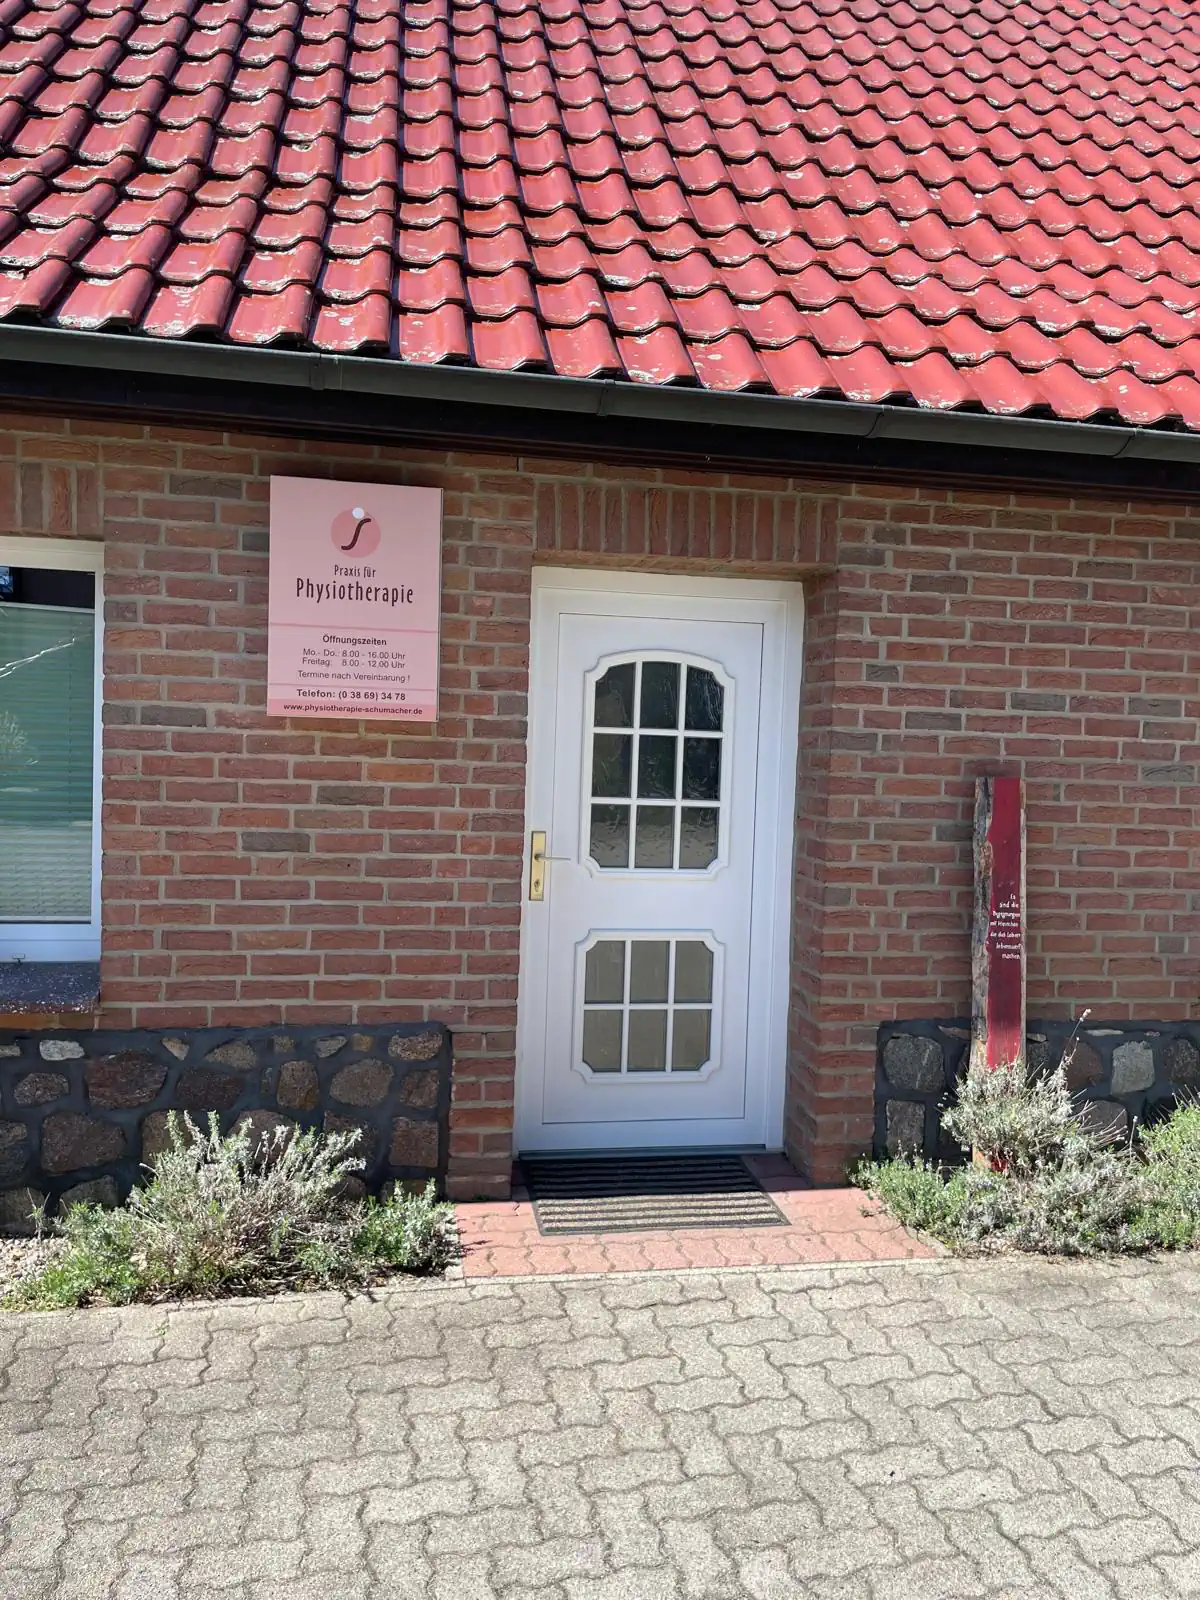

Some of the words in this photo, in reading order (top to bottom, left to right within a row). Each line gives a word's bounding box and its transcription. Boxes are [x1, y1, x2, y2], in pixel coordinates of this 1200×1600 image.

[334, 564, 361, 577] Praxis
[363, 566, 376, 578] für
[296, 577, 414, 607] Physiotherapie
[322, 633, 387, 646] Öffnungszeiten
[342, 650, 360, 658] 8.00
[368, 651, 390, 660] 16.00
[391, 652, 406, 660] Uhr
[342, 659, 360, 667] 8.00
[368, 660, 390, 669] 12.00
[391, 661, 406, 669] Uhr
[298, 669, 330, 679] Termine
[331, 672, 352, 680] nach
[353, 673, 406, 684] Vereinbarung
[296, 688, 336, 698] Telefon:
[338, 690, 348, 700] (0
[350, 691, 361, 699] 38
[363, 691, 379, 702] 69)
[380, 692, 392, 700] 34
[394, 692, 406, 701] 78
[283, 703, 423, 715] www.physiotherapie-schumacher.de
